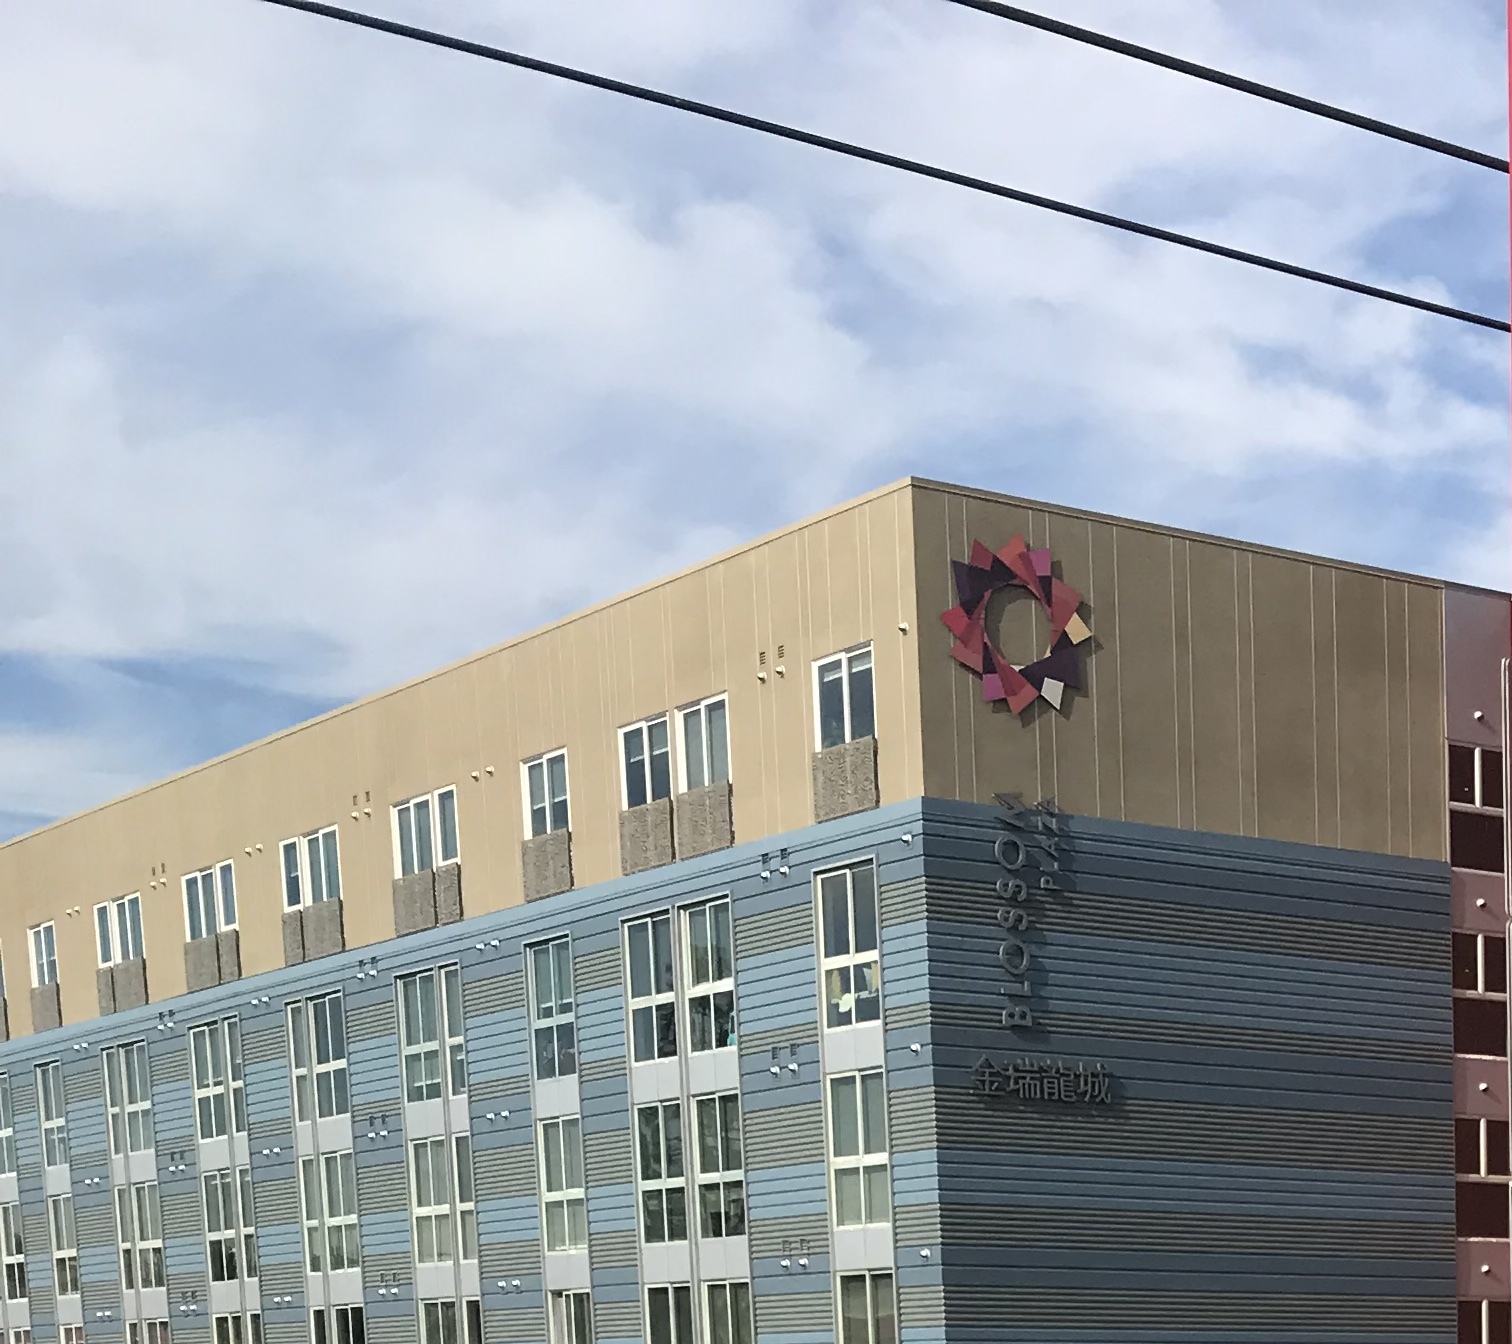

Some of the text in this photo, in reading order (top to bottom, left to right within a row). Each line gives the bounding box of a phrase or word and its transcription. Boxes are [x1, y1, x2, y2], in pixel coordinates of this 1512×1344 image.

[992, 791, 1032, 1028] BLOSSOM
[970, 1053, 1112, 1104] 金瑞龍城
